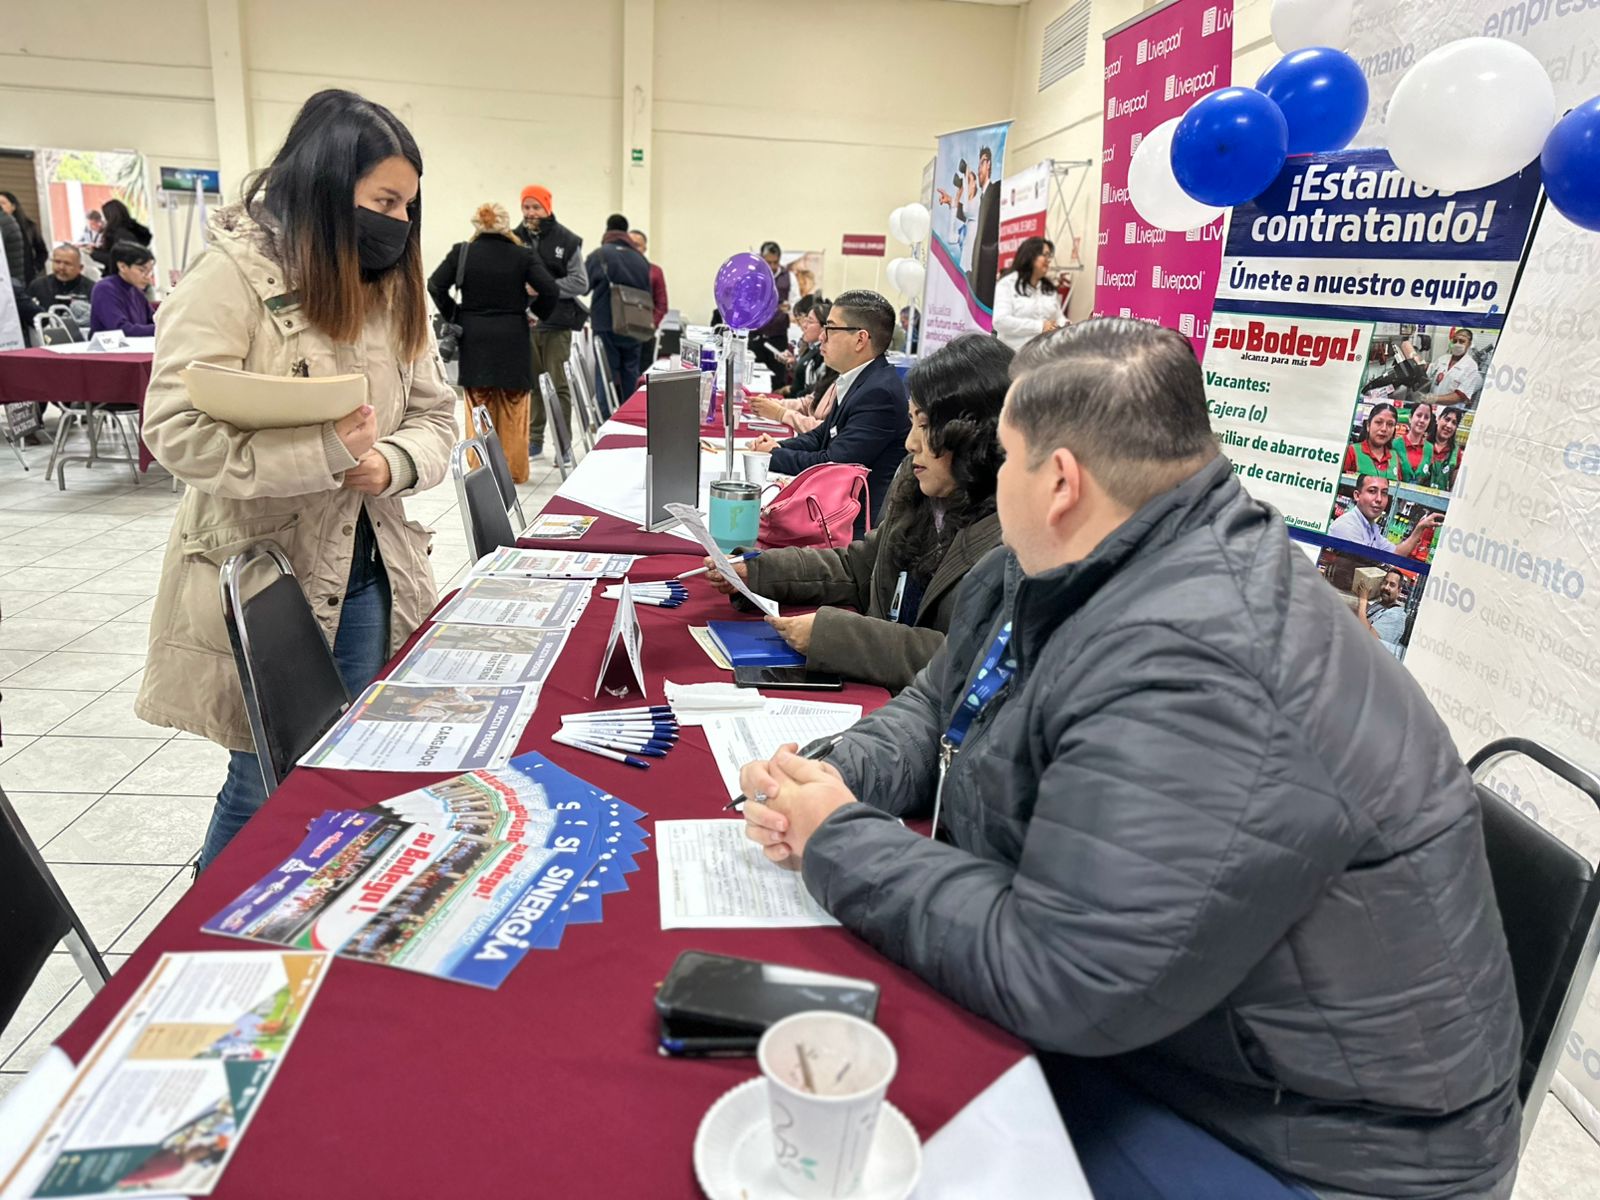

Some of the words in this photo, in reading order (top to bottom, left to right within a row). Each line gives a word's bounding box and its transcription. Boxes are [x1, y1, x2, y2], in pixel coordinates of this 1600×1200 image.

[1148, 28, 1183, 60] Liverpool
[1175, 66, 1217, 98] Liverpool
[1116, 90, 1149, 118] Liverpool
[1109, 187, 1130, 206] Liverp
[1287, 163, 1456, 211] ¡Estam
[1202, 218, 1224, 242] Liv
[1251, 200, 1497, 243] contratando!
[1103, 270, 1136, 292] Liverpool
[1161, 271, 1202, 294] Liverpool
[1229, 261, 1292, 291] Únete
[1297, 275, 1308, 292] a
[1314, 273, 1405, 297] nuestro
[1411, 272, 1498, 307] equipo
[1212, 321, 1360, 367] suBodega!
[1240, 352, 1269, 364] alcanza
[1270, 357, 1290, 366] para
[1292, 357, 1308, 367] más
[1206, 371, 1270, 393] Vacantes:
[1206, 399, 1250, 419] Cajera
[1249, 404, 1268, 423] (o)
[1217, 430, 1250, 448] xiliar
[1252, 435, 1268, 451] de
[1270, 439, 1340, 464] abarrotes
[1247, 463, 1264, 479] de
[1265, 470, 1334, 494] carnicería
[1294, 516, 1322, 530] jornada)
[487, 704, 510, 730] SOLICITA
[416, 725, 453, 767] CARGADOR
[472, 730, 499, 759] PERSONAL
